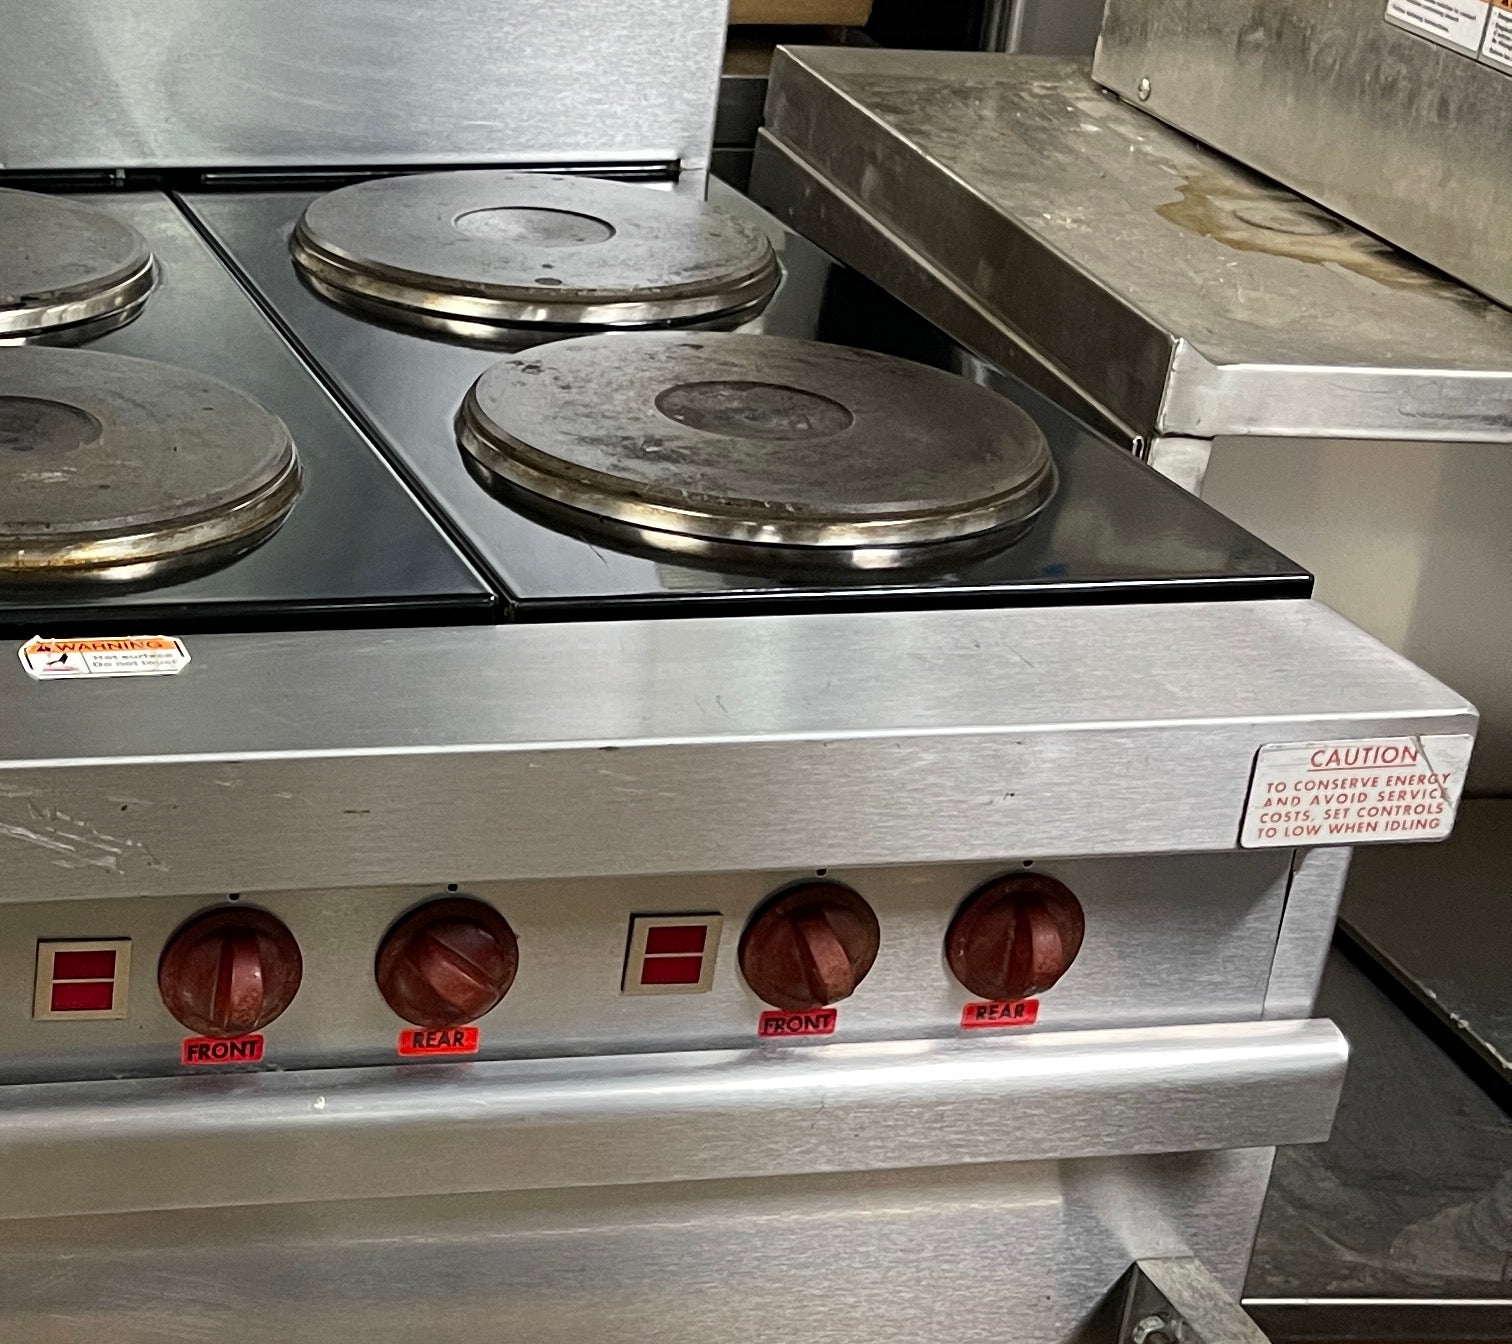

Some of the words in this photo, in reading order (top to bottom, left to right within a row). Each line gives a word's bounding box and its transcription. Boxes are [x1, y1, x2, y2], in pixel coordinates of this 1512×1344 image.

[55, 640, 163, 652] WARNING
[1310, 745, 1420, 768] CAUTION
[1266, 781, 1287, 794] TO
[1294, 776, 1379, 792] CONSERVE
[1386, 772, 1452, 787] ENERGY
[1263, 796, 1301, 807] AND
[1310, 792, 1368, 806] AVOID
[1260, 809, 1316, 824] COSTS,
[1323, 807, 1351, 820] SET
[1357, 803, 1444, 819] CONTROLS
[1257, 827, 1277, 839] TO
[1284, 825, 1322, 838] LOW
[1329, 821, 1378, 835] WHEN
[1384, 817, 1441, 832] IDLING
[974, 1003, 1026, 1021] REAR
[763, 1014, 833, 1034] FRONT
[413, 1030, 465, 1049] REAR
[188, 1039, 258, 1061] FRONT
